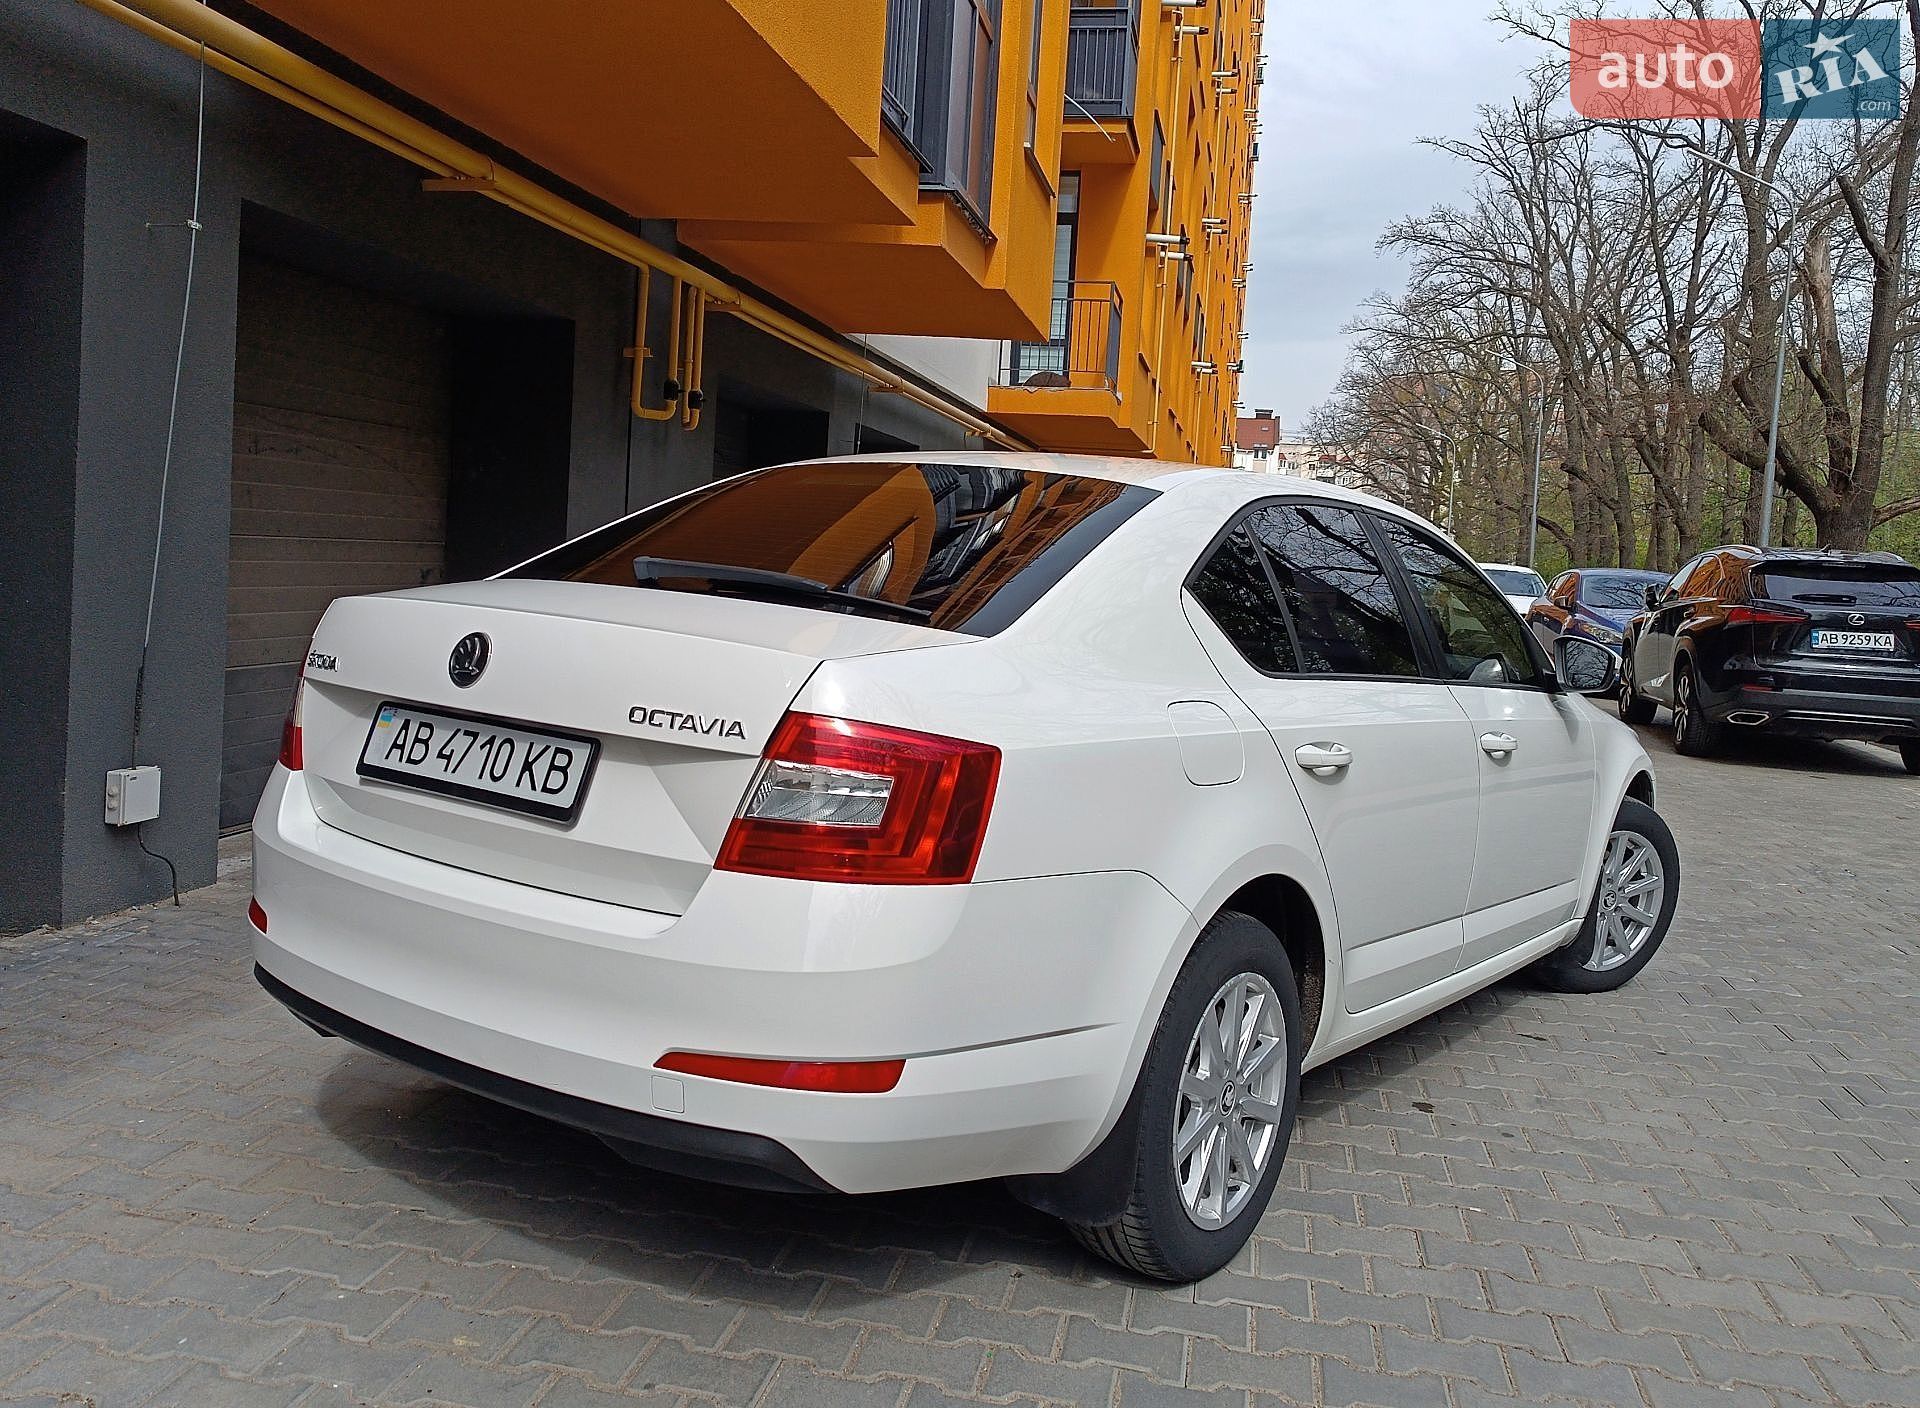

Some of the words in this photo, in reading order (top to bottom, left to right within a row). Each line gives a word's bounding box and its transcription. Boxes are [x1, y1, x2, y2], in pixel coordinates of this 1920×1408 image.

[1821, 633, 1838, 644] AB
[1841, 633, 1871, 646] 9259
[1873, 635, 1892, 646] KA
[628, 706, 746, 740] OCTAVIA
[384, 718, 435, 765] AB
[436, 728, 516, 783] 4710
[515, 741, 574, 795] KB
